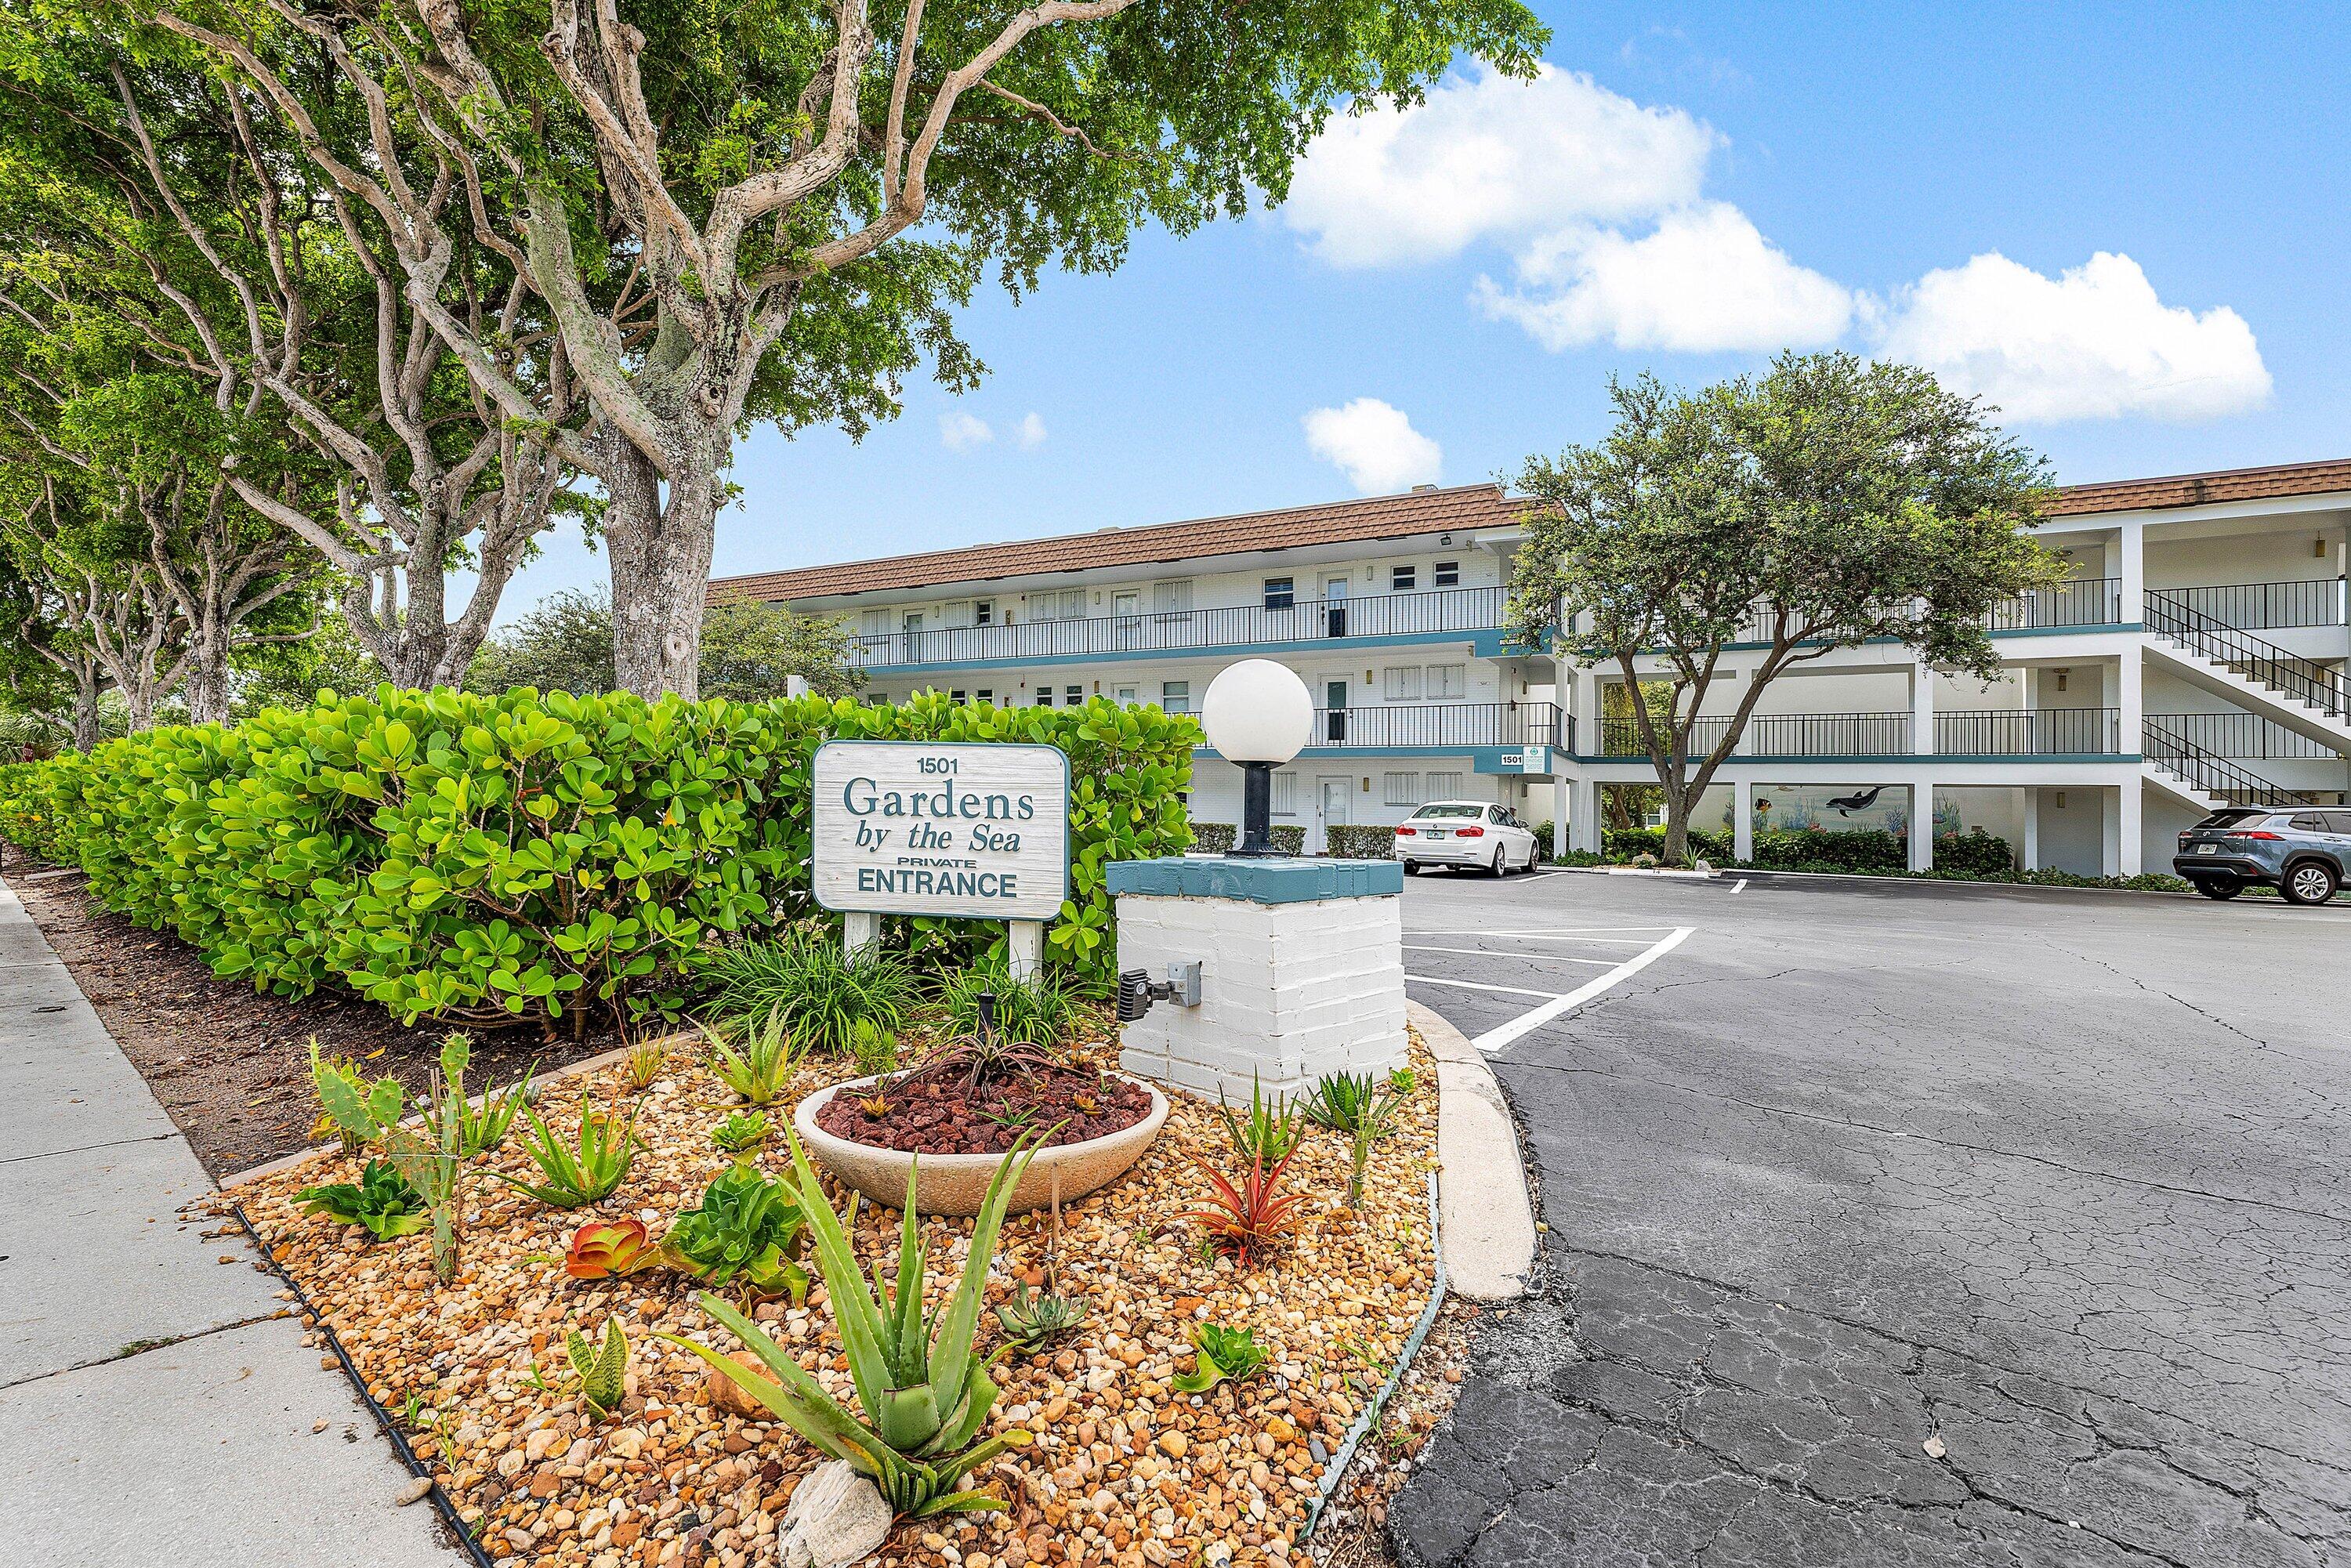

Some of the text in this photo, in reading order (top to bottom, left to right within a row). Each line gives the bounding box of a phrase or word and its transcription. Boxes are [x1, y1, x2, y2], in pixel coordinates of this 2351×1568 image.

[917, 757, 958, 774] 1501
[843, 777, 1034, 820] Gardens
[855, 820, 1021, 853] by the Sea
[897, 856, 977, 868] PRIVATE
[858, 868, 1017, 898] ENTRANCE
